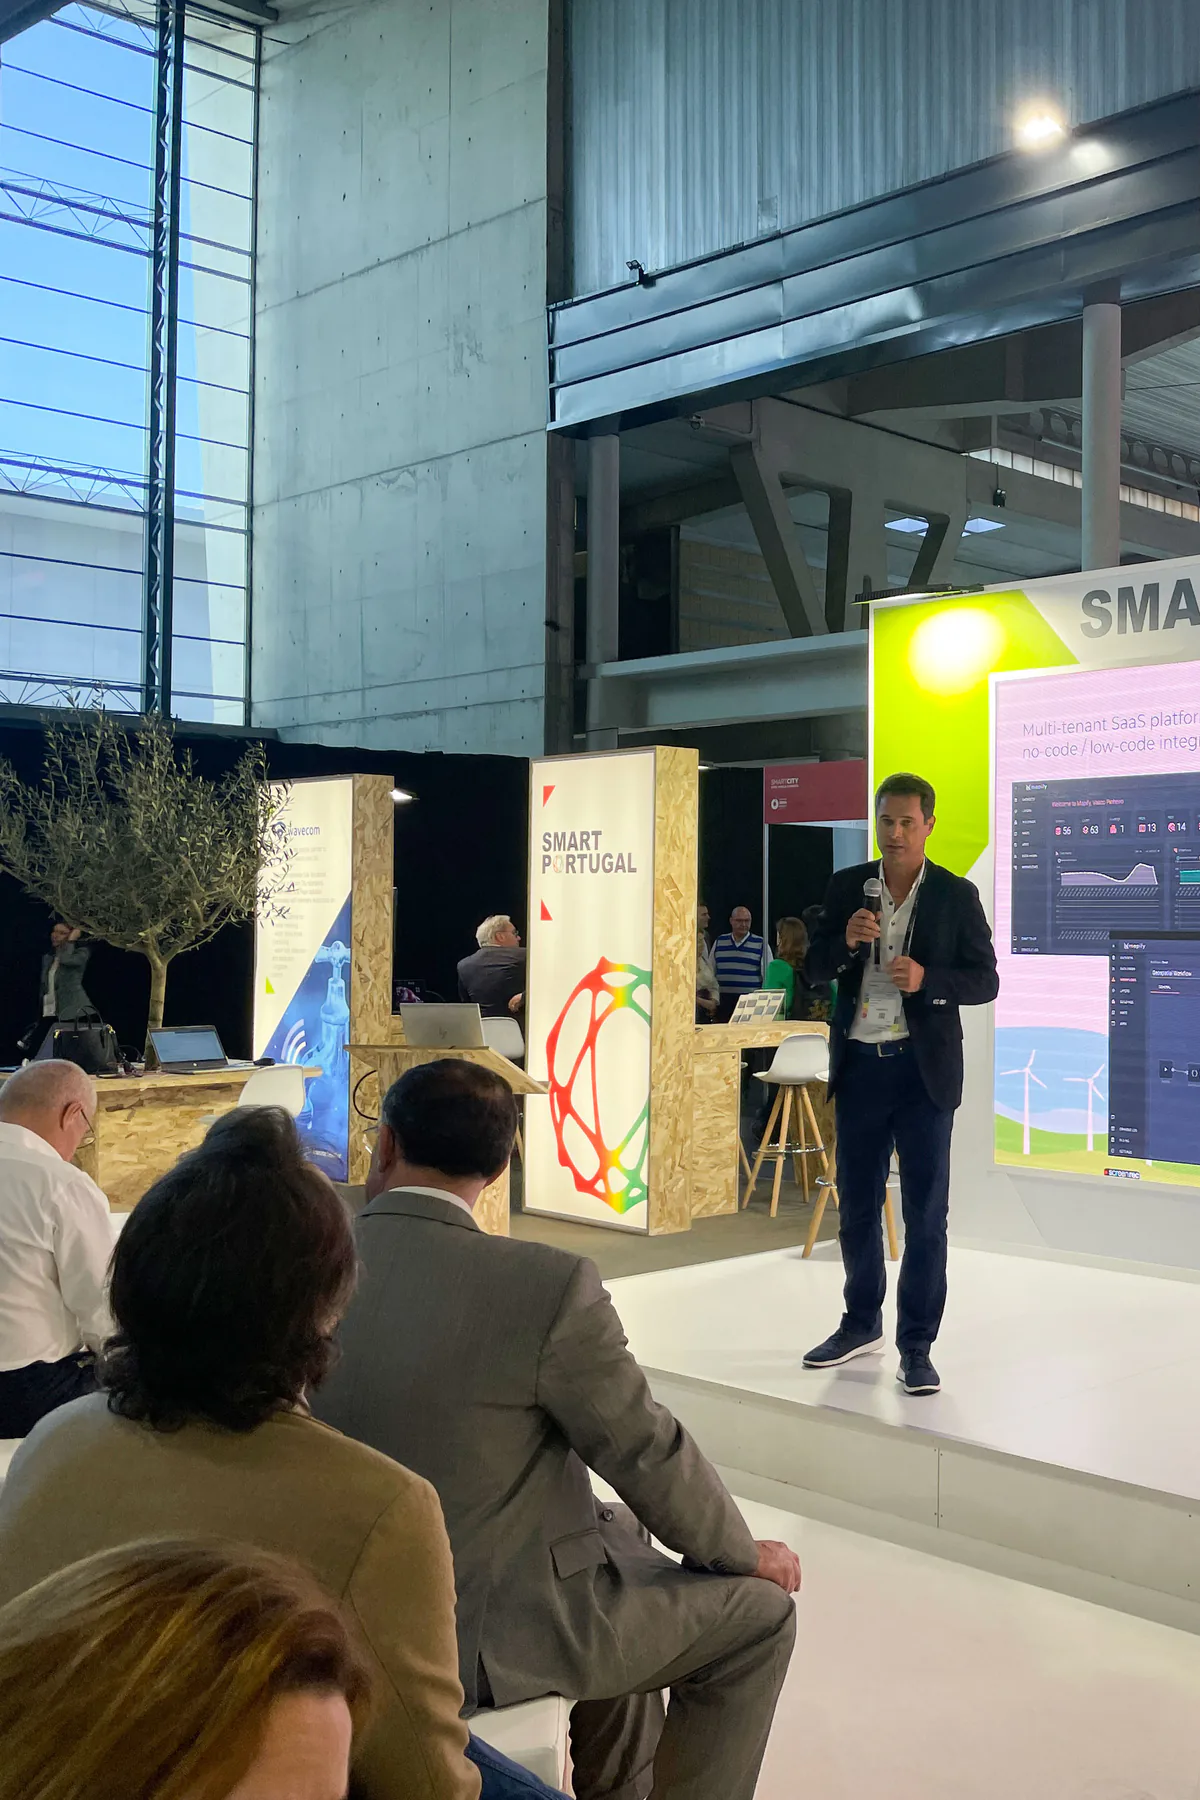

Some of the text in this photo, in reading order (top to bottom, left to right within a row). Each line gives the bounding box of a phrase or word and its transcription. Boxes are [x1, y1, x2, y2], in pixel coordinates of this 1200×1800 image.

[1023, 718, 1107, 736] Multi-tenant
[1111, 714, 1146, 730] SaaS
[1023, 742, 1078, 758] no-code
[1090, 736, 1155, 754] low-code
[288, 825, 320, 836] wavecom
[1062, 826, 1072, 836] 56
[1089, 825, 1099, 835] 63
[1147, 823, 1157, 833] 13
[1177, 822, 1187, 832] 14
[542, 830, 602, 852] SMART
[541, 852, 637, 874] PORTUGAL
